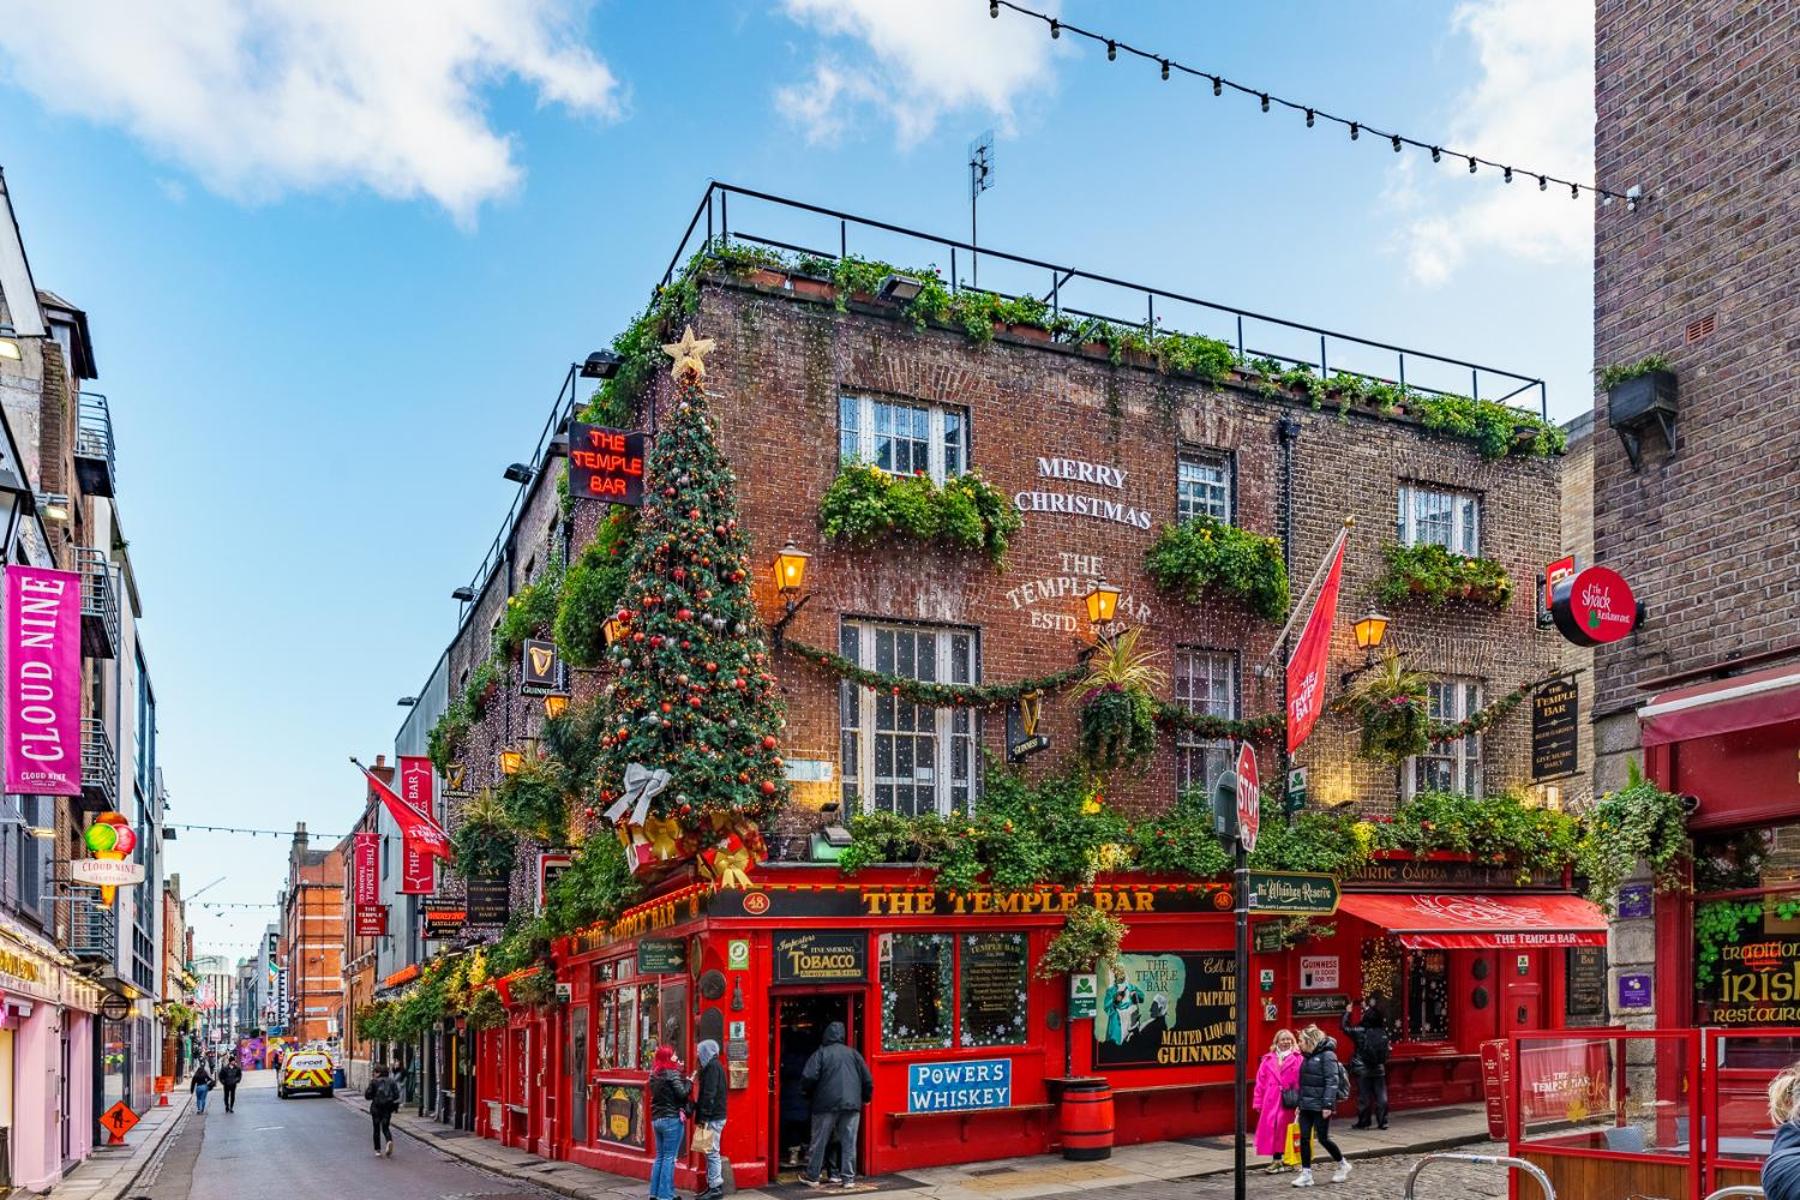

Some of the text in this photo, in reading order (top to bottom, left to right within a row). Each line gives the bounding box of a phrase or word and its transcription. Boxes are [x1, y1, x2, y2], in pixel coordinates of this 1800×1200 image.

[590, 430, 625, 452] THE
[572, 450, 642, 475] TEMPLE
[1037, 456, 1128, 489] MERRY
[590, 475, 626, 496] BAR
[1014, 491, 1151, 530] CHRISTMAS
[1059, 552, 1104, 576] THE
[1117, 593, 1152, 625] AR
[1582, 583, 1611, 613] Shack
[20, 576, 66, 649] NINE
[1536, 690, 1577, 708] TEMPLE
[20, 661, 65, 762] CLOUD
[1544, 704, 1567, 717] BAR
[1239, 774, 1259, 819] STOP
[408, 775, 420, 875] THE BAR
[82, 862, 136, 874] CLOUD NINE
[863, 891, 1155, 915] THE TEMPLE BAR
[652, 901, 675, 930] BAR
[1494, 933, 1516, 944] THE
[1518, 932, 1556, 944] TEMPLE
[1557, 932, 1576, 944] BAR
[787, 950, 855, 976] TOBACCO
[1145, 959, 1169, 970] THE
[1302, 960, 1337, 969] GUINNESS
[1135, 970, 1177, 982] TEMPLE
[1146, 982, 1169, 992] BAR
[1221, 976, 1236, 991] TH
[1196, 991, 1236, 1007] EMPERO
[1161, 1029, 1202, 1046] MALTED
[917, 1064, 1004, 1086] POWER'S
[911, 1087, 1009, 1110] WHISKEY
